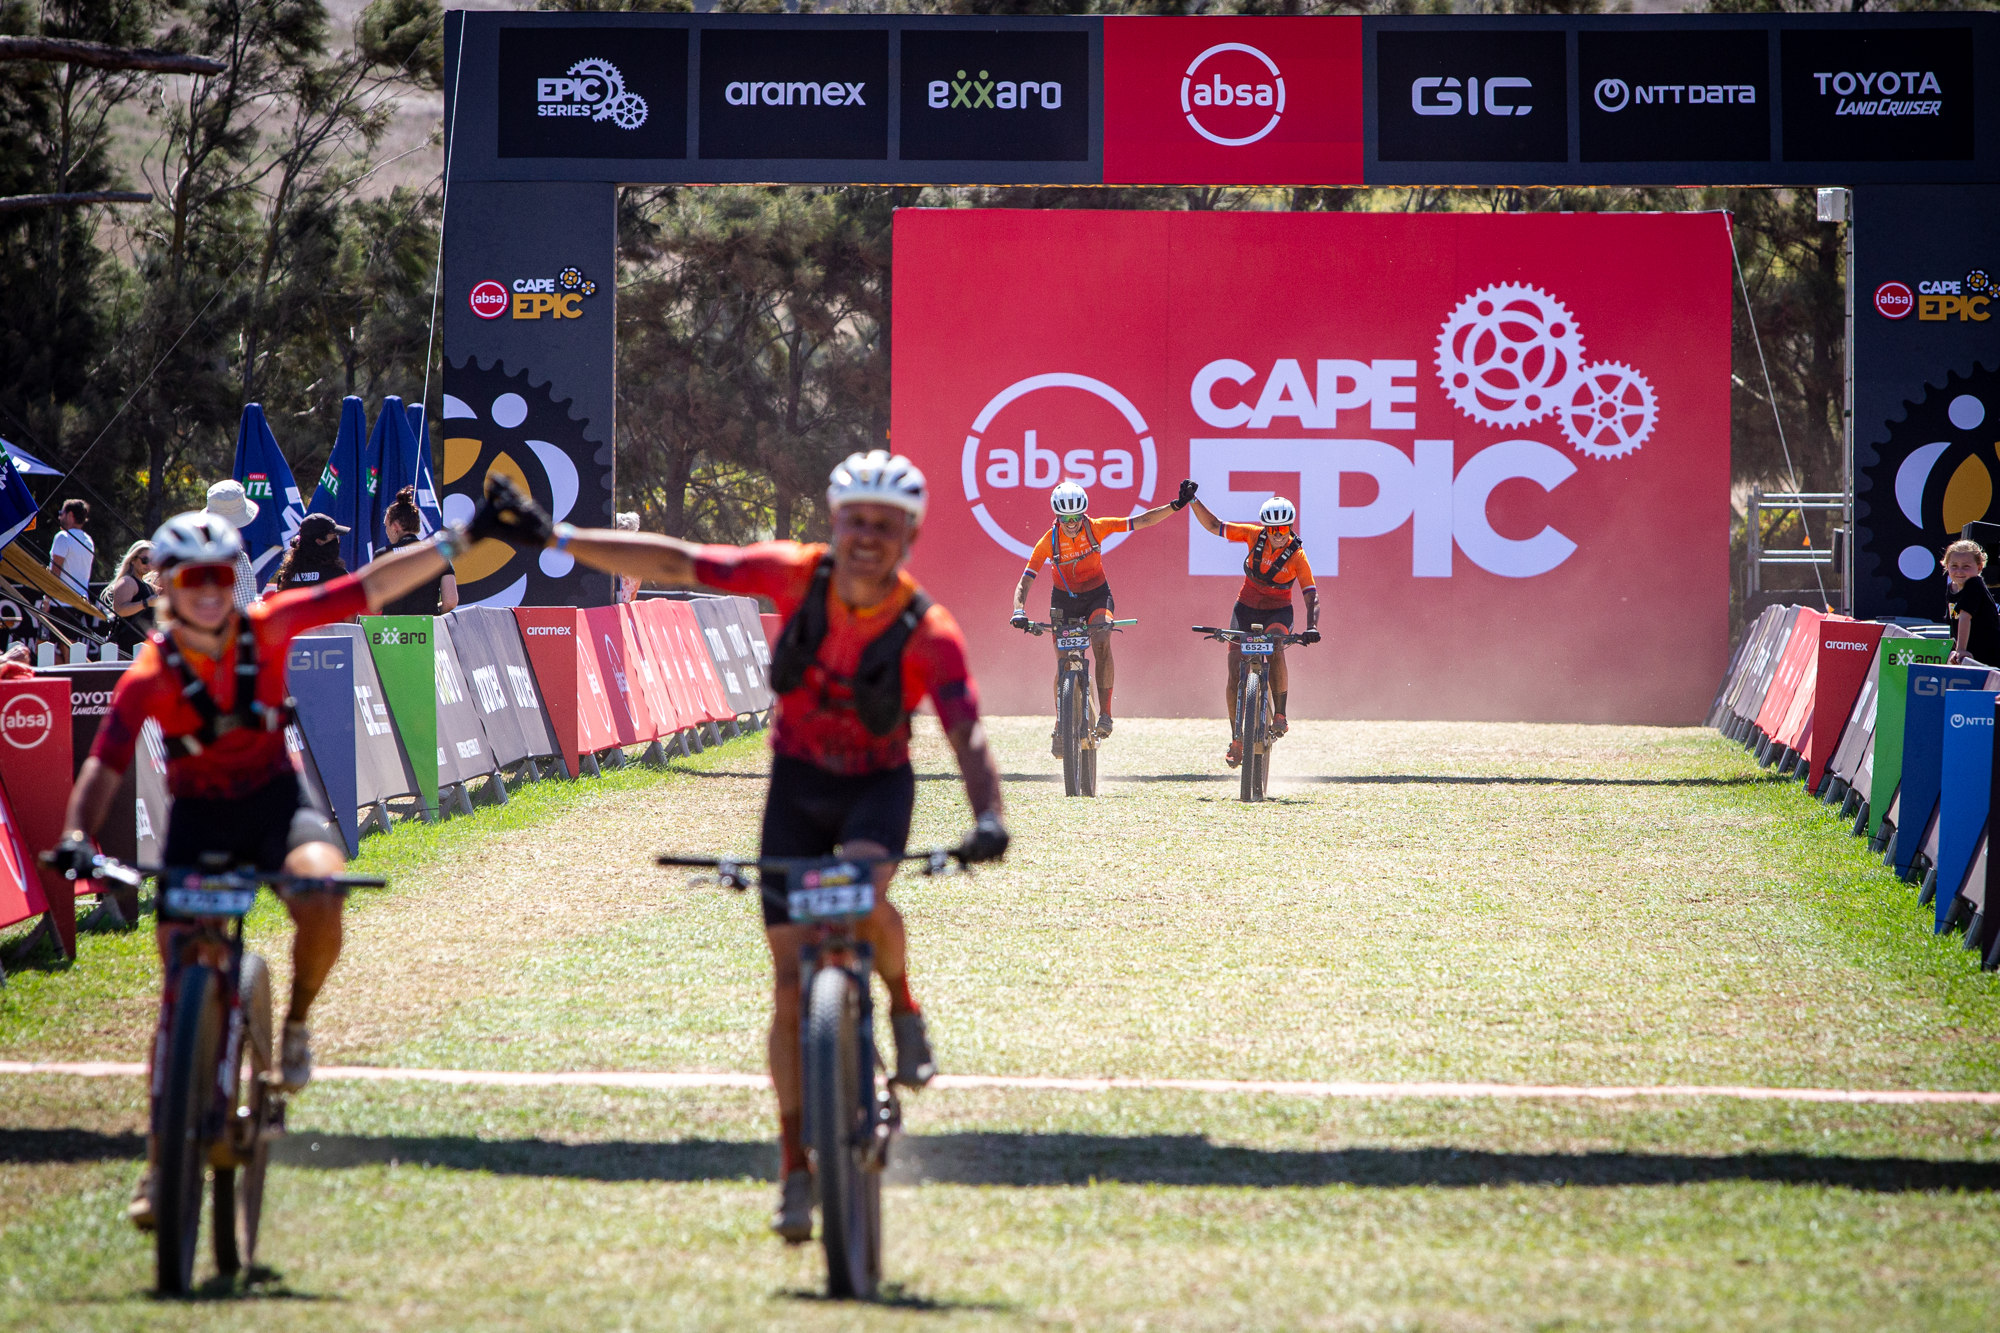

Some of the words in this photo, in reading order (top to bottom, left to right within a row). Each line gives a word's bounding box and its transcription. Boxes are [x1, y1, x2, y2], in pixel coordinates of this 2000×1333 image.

[537, 77, 602, 103] EPIC
[928, 71, 1062, 110] exxaro
[1193, 73, 1274, 107] absa
[1813, 71, 1942, 96] TOYOTA
[725, 81, 866, 107] aramex
[1411, 76, 1533, 116] GIC
[1635, 85, 1686, 104] NTT
[537, 104, 592, 117] SERIES
[513, 279, 554, 292] CAPE
[1919, 281, 1961, 294] CAPE
[475, 292, 503, 304] absa
[513, 293, 583, 319] EPIC
[1880, 293, 1909, 304] absa
[1918, 295, 1991, 321] EPIC
[1190, 358, 1418, 430] CAPE
[985, 429, 1135, 489] absa
[246, 481, 273, 496] ITE
[1188, 438, 1578, 577] EPIC
[372, 627, 427, 645] exxaro
[526, 626, 571, 635] aramex
[1060, 637, 1087, 647] 652-2
[1245, 643, 1270, 651] 652-1
[1824, 640, 1868, 651] aramex
[287, 650, 345, 671] GIC
[70, 691, 113, 705] OYOT
[5, 710, 47, 728] absa
